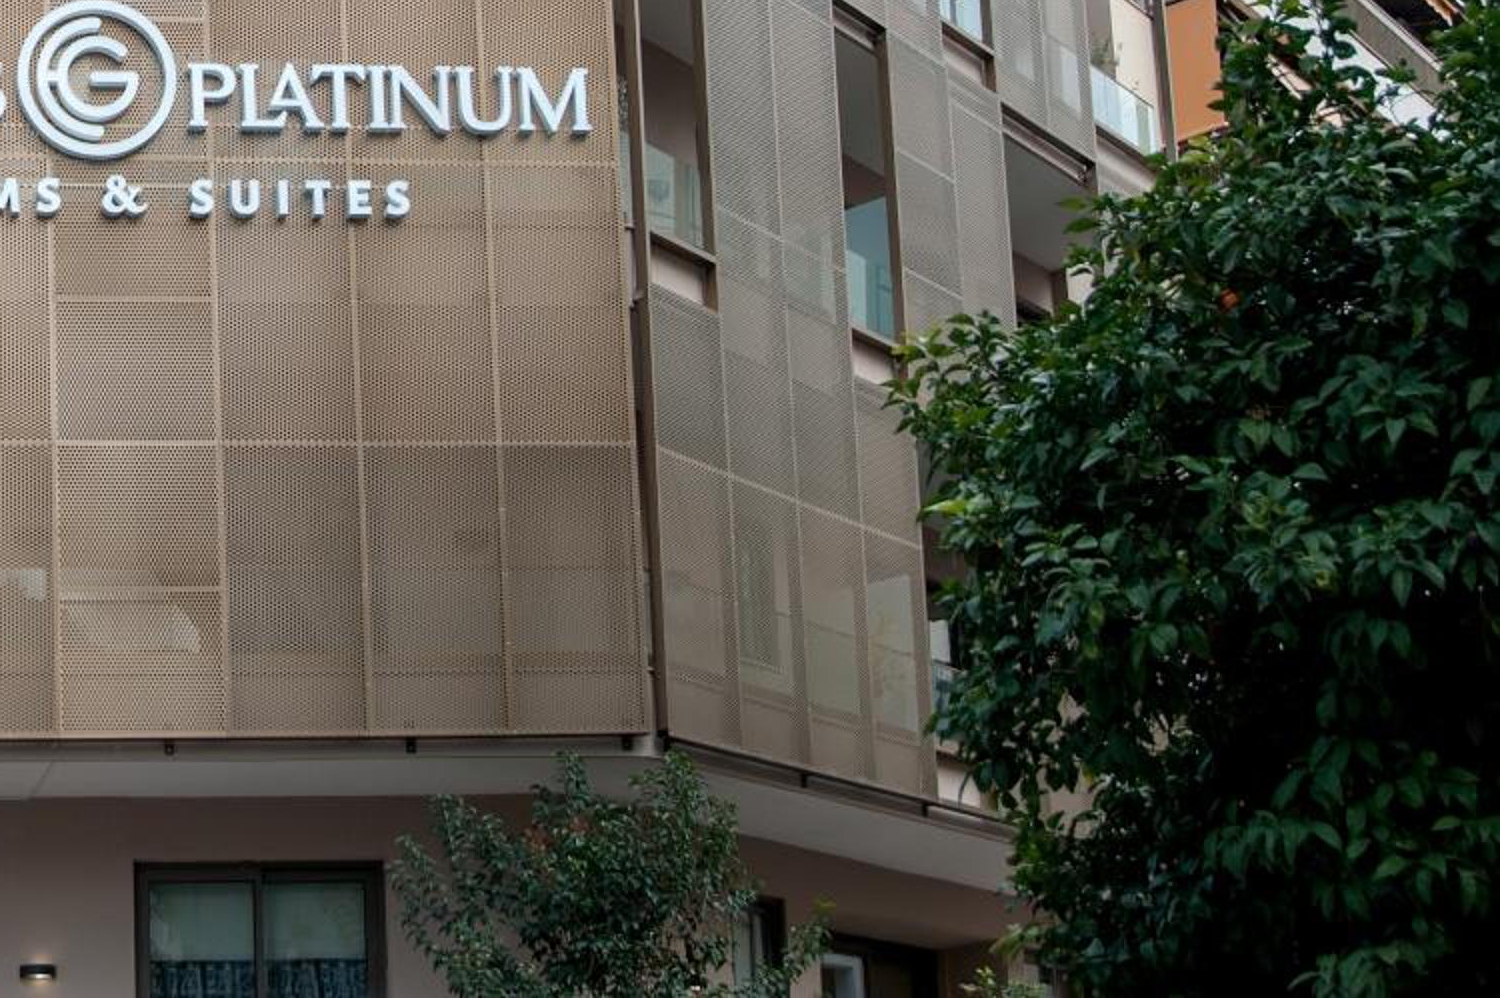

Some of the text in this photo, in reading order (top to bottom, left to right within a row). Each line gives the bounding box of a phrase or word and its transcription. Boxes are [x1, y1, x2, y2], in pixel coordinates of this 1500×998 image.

[188, 60, 592, 138] PLATINUM
[103, 175, 147, 219] &
[188, 177, 412, 219] SUITES
